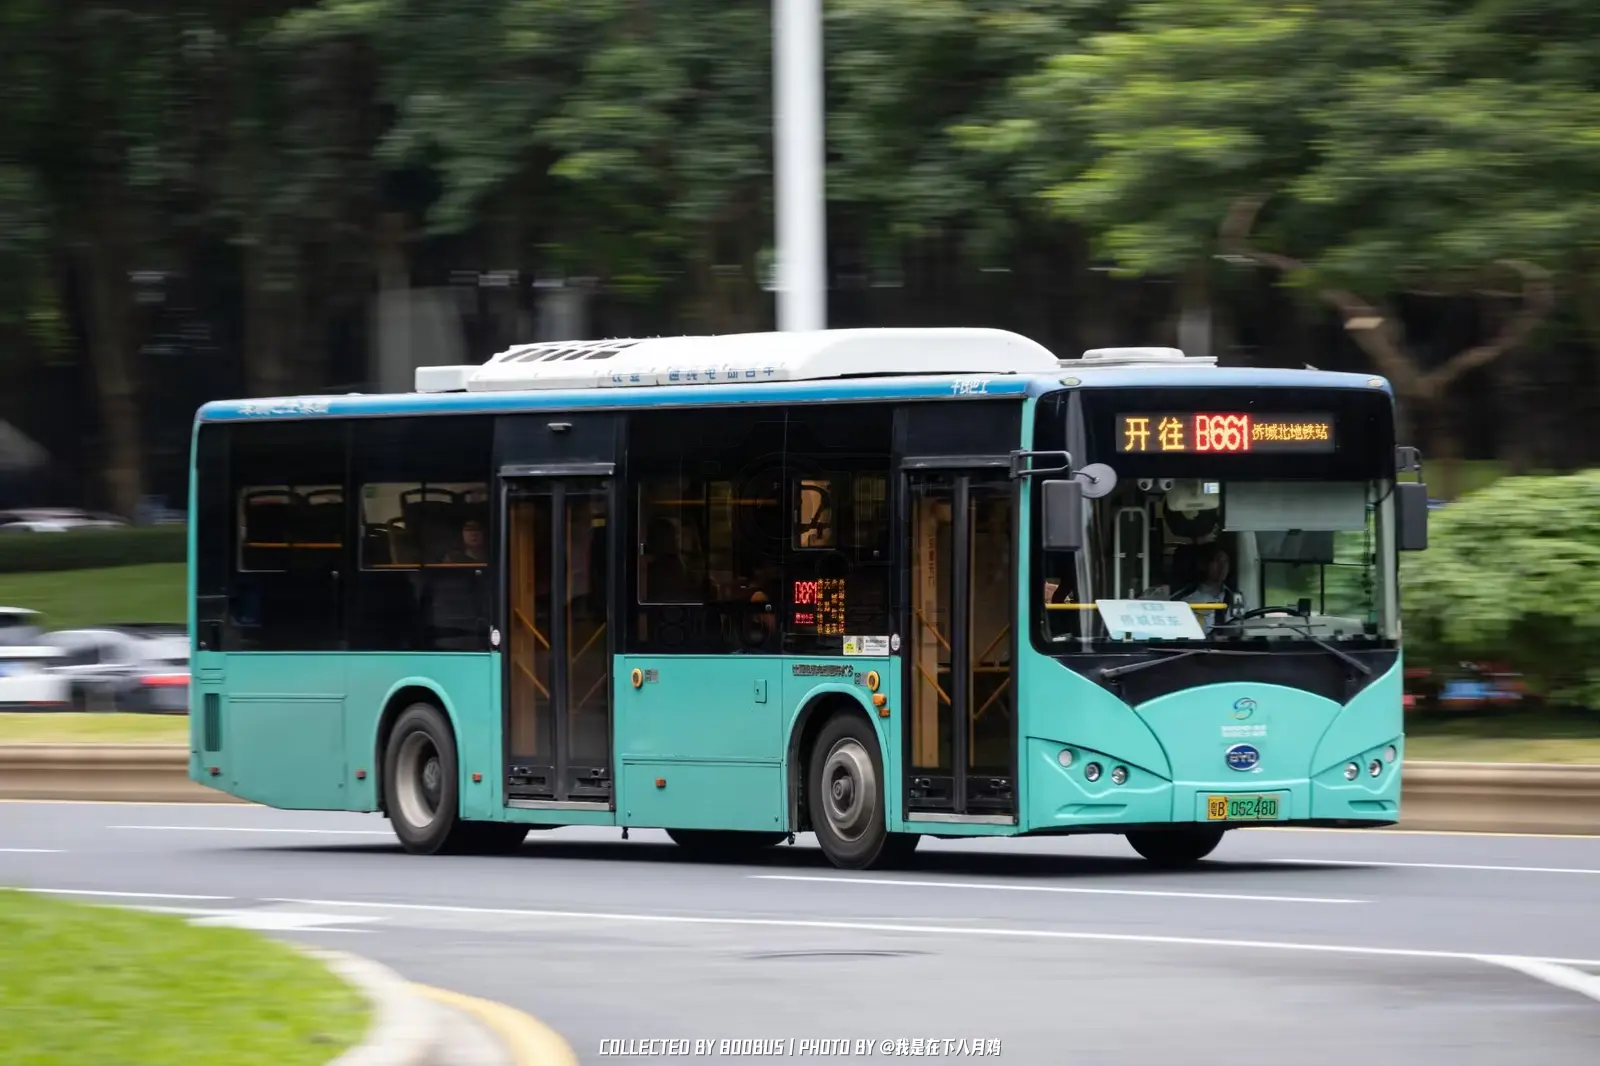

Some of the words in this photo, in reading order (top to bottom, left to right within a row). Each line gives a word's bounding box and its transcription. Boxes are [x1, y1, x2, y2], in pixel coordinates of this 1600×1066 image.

[1124, 417, 1185, 450] 开往
[1195, 415, 1248, 450] B661
[1251, 423, 1329, 440] 侨城北地铁站
